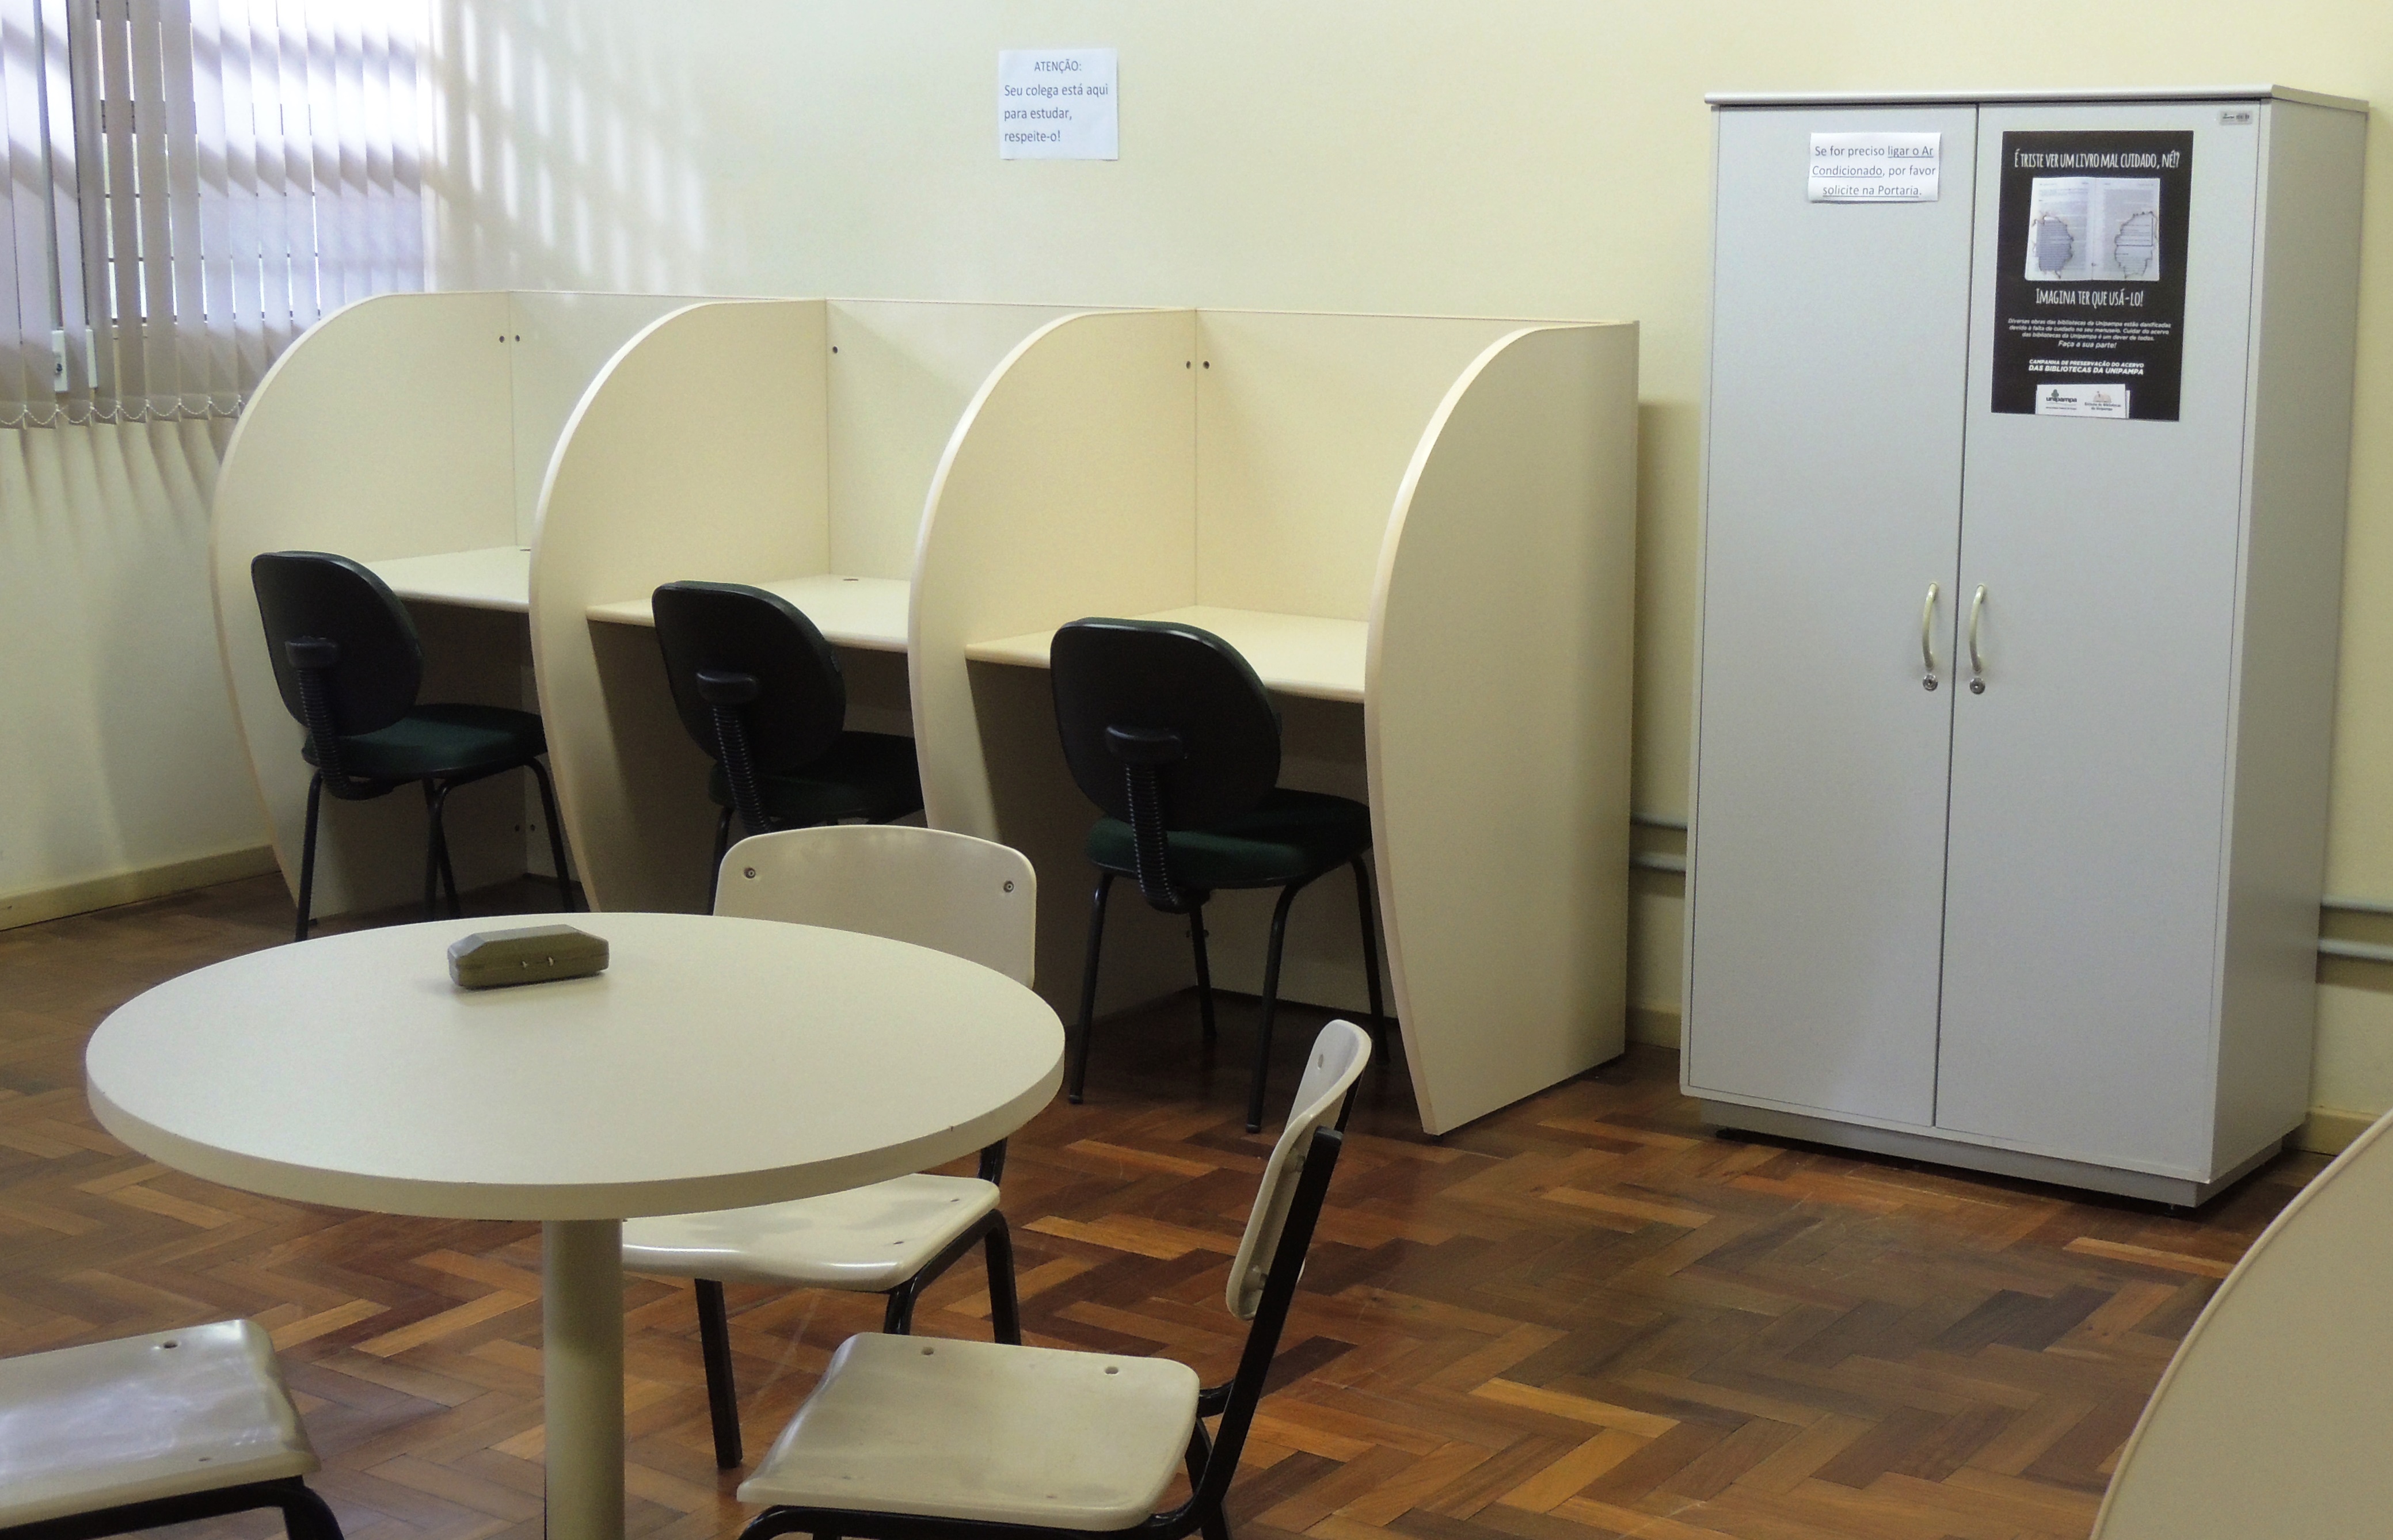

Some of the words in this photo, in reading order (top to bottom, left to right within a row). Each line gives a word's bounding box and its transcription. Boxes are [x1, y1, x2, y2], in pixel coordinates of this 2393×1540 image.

[1034, 59, 1082, 74] ATENÇÃO:
[1005, 85, 1022, 96] Seu
[1026, 84, 1059, 98] colega
[1062, 83, 1083, 96] está
[1086, 83, 1108, 97] aqui
[1005, 110, 1027, 121] para
[1030, 107, 1072, 120] estudar,
[1005, 130, 1060, 144] respeite-o!
[1815, 146, 1827, 157] Se
[1831, 146, 1845, 157] for
[1848, 146, 1885, 158] preciso
[1888, 146, 1909, 157] ligar
[1922, 146, 1934, 156] Ar
[2015, 148, 2021, 168] É
[2020, 153, 2044, 168] TRISTE
[2045, 153, 2059, 168] VER
[2060, 153, 2074, 168] UM
[2075, 153, 2099, 168] LIVRO
[2101, 153, 2119, 168] MAL
[2121, 153, 2160, 170] CUIDADO,
[1812, 165, 1885, 177] Condicionado,
[1889, 167, 1905, 177] por
[1909, 165, 1936, 176] favor
[1823, 185, 1859, 195] solicite
[1862, 187, 1874, 195] na
[1878, 185, 1922, 196] Portaria.
[2078, 290, 2090, 306] TER
[2092, 291, 2108, 309] QUE
[2109, 288, 2144, 307] USÁ-LO!
